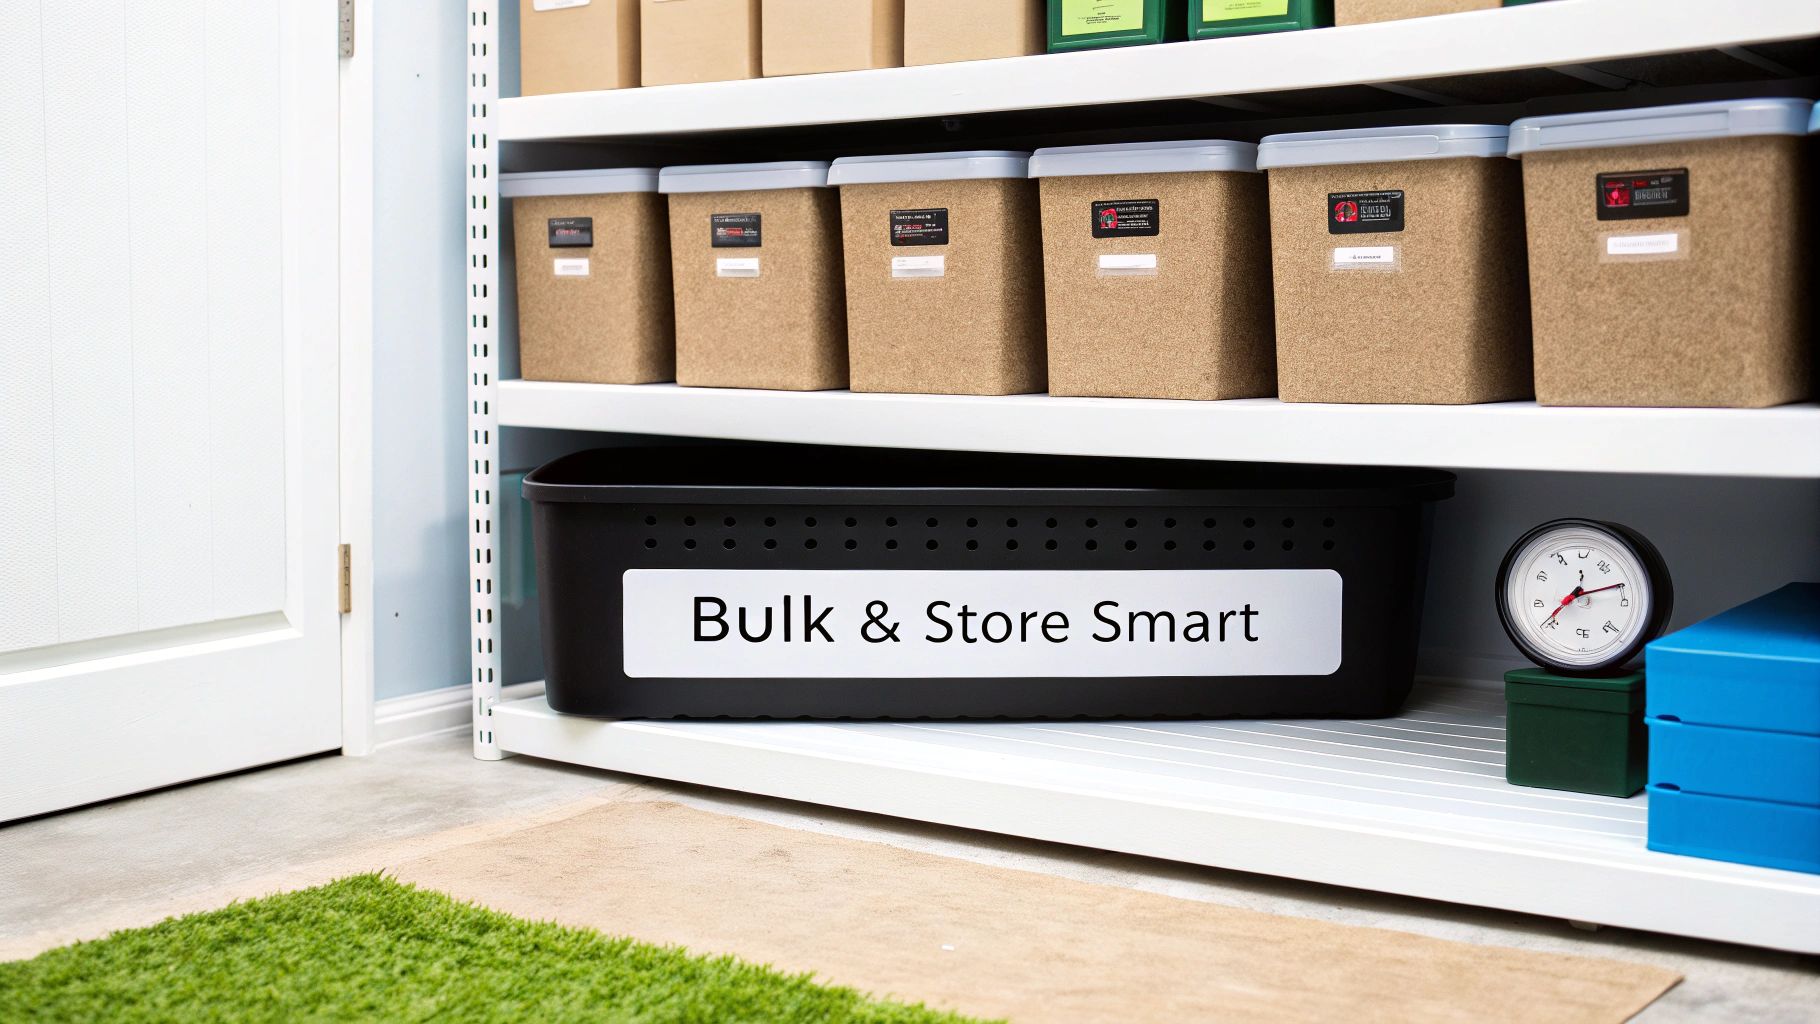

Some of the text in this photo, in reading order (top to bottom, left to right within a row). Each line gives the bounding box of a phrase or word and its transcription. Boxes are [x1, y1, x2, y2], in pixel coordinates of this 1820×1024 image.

[693, 594, 1259, 644] Bulk & Store Smart
